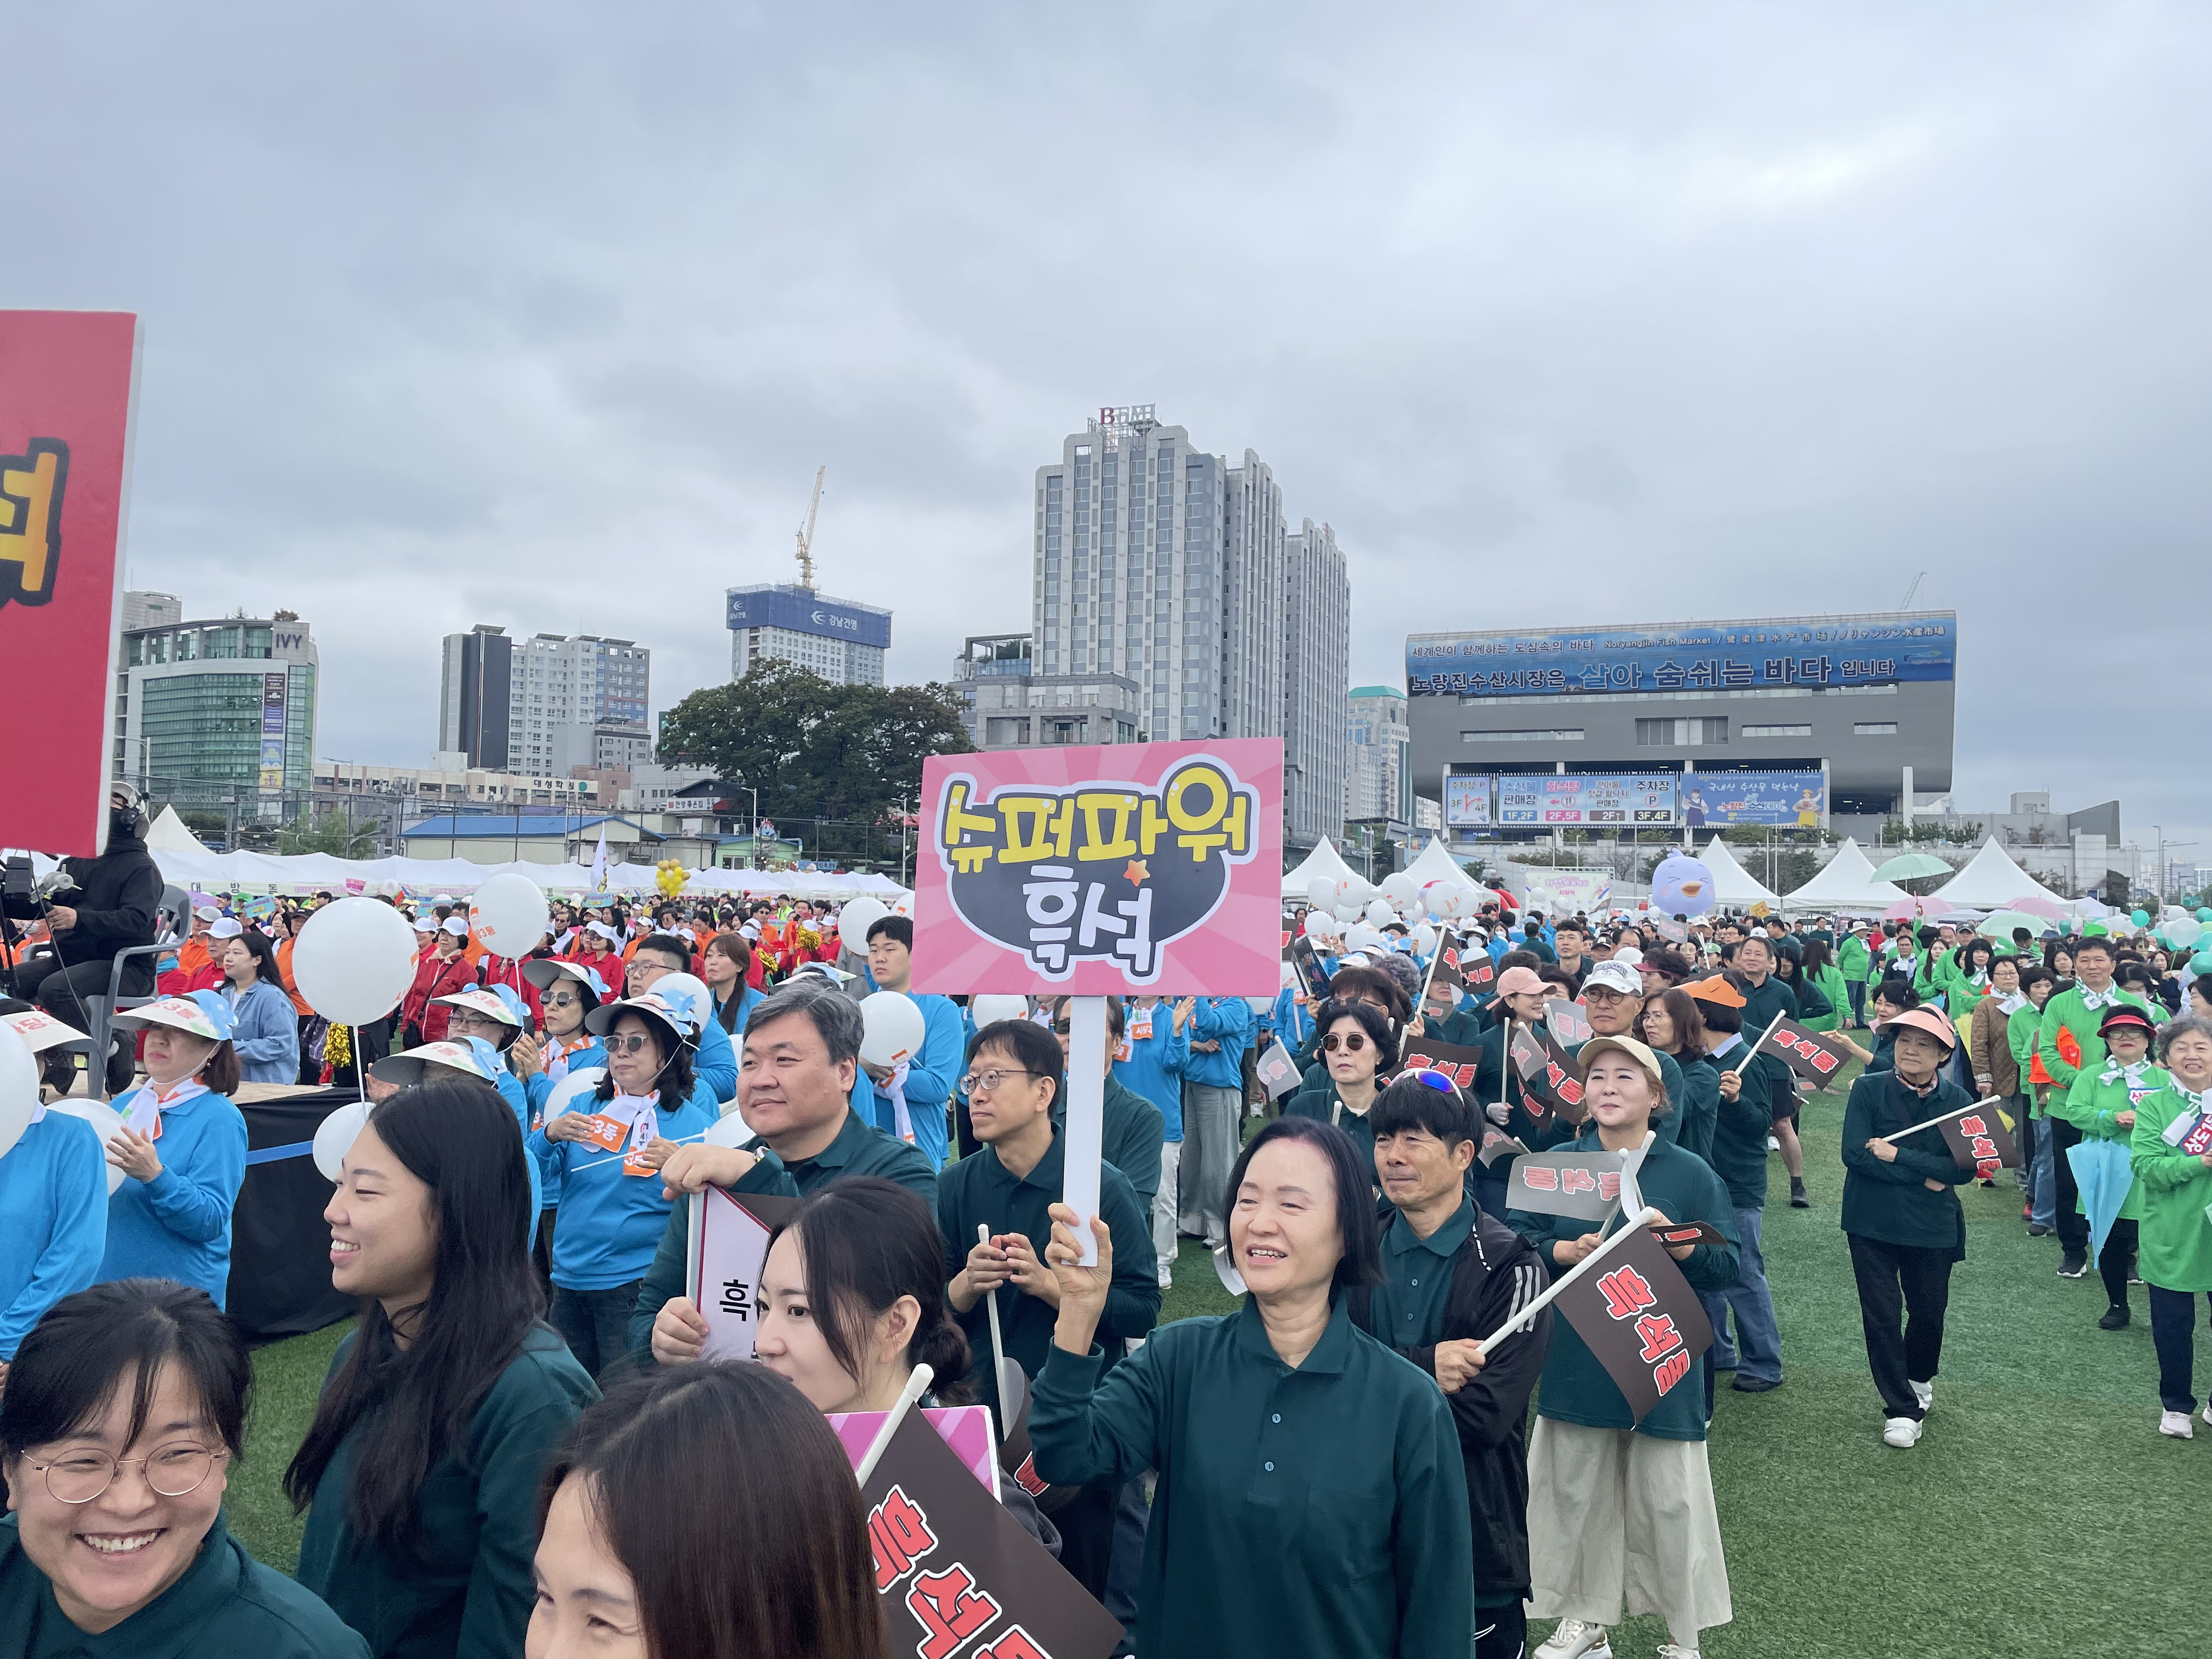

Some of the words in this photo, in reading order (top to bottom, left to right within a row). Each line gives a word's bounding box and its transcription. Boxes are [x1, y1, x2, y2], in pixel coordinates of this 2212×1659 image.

[829, 614, 857, 630] 강남건영
[276, 634, 302, 649] IVY
[1412, 646, 1457, 658] 세계인이
[1463, 644, 1509, 656] 함께하는
[1514, 640, 1563, 654] 도심속의
[1570, 639, 1595, 652] 바다
[1604, 639, 1654, 649] Noryangjin
[1657, 638, 1675, 646] Fish
[1679, 636, 1711, 646] Market
[1412, 669, 1565, 692] 노량진수산시장은
[1578, 662, 1642, 690] 살아
[1653, 658, 1754, 688] 숨쉬는
[1764, 655, 1832, 684] 바다
[1840, 658, 1895, 677] 입니다
[1451, 781, 1475, 790] 주차장
[1503, 781, 1537, 793] 수산물
[1547, 780, 1581, 792] 회식당
[1596, 780, 1620, 789] 건어물
[1635, 781, 1670, 791] 주차장
[1708, 782, 1736, 792] 국내산
[1740, 782, 1767, 792] 수산물
[1771, 782, 1799, 792] 먹는날
[1504, 794, 1537, 805] 판매장
[1475, 804, 1487, 812] 4F
[945, 766, 1248, 874] 슈퍼파워
[1508, 811, 1533, 821] 1F,2F
[1549, 811, 1578, 820] 2F,5F
[1602, 811, 1615, 820] 2F
[1638, 811, 1668, 821] 3F,4F
[1023, 865, 1153, 972] 흑석
[1772, 1029, 1839, 1074] 흑석동
[594, 1120, 618, 1142] 3동
[1596, 1264, 1690, 1397] 흑석동
